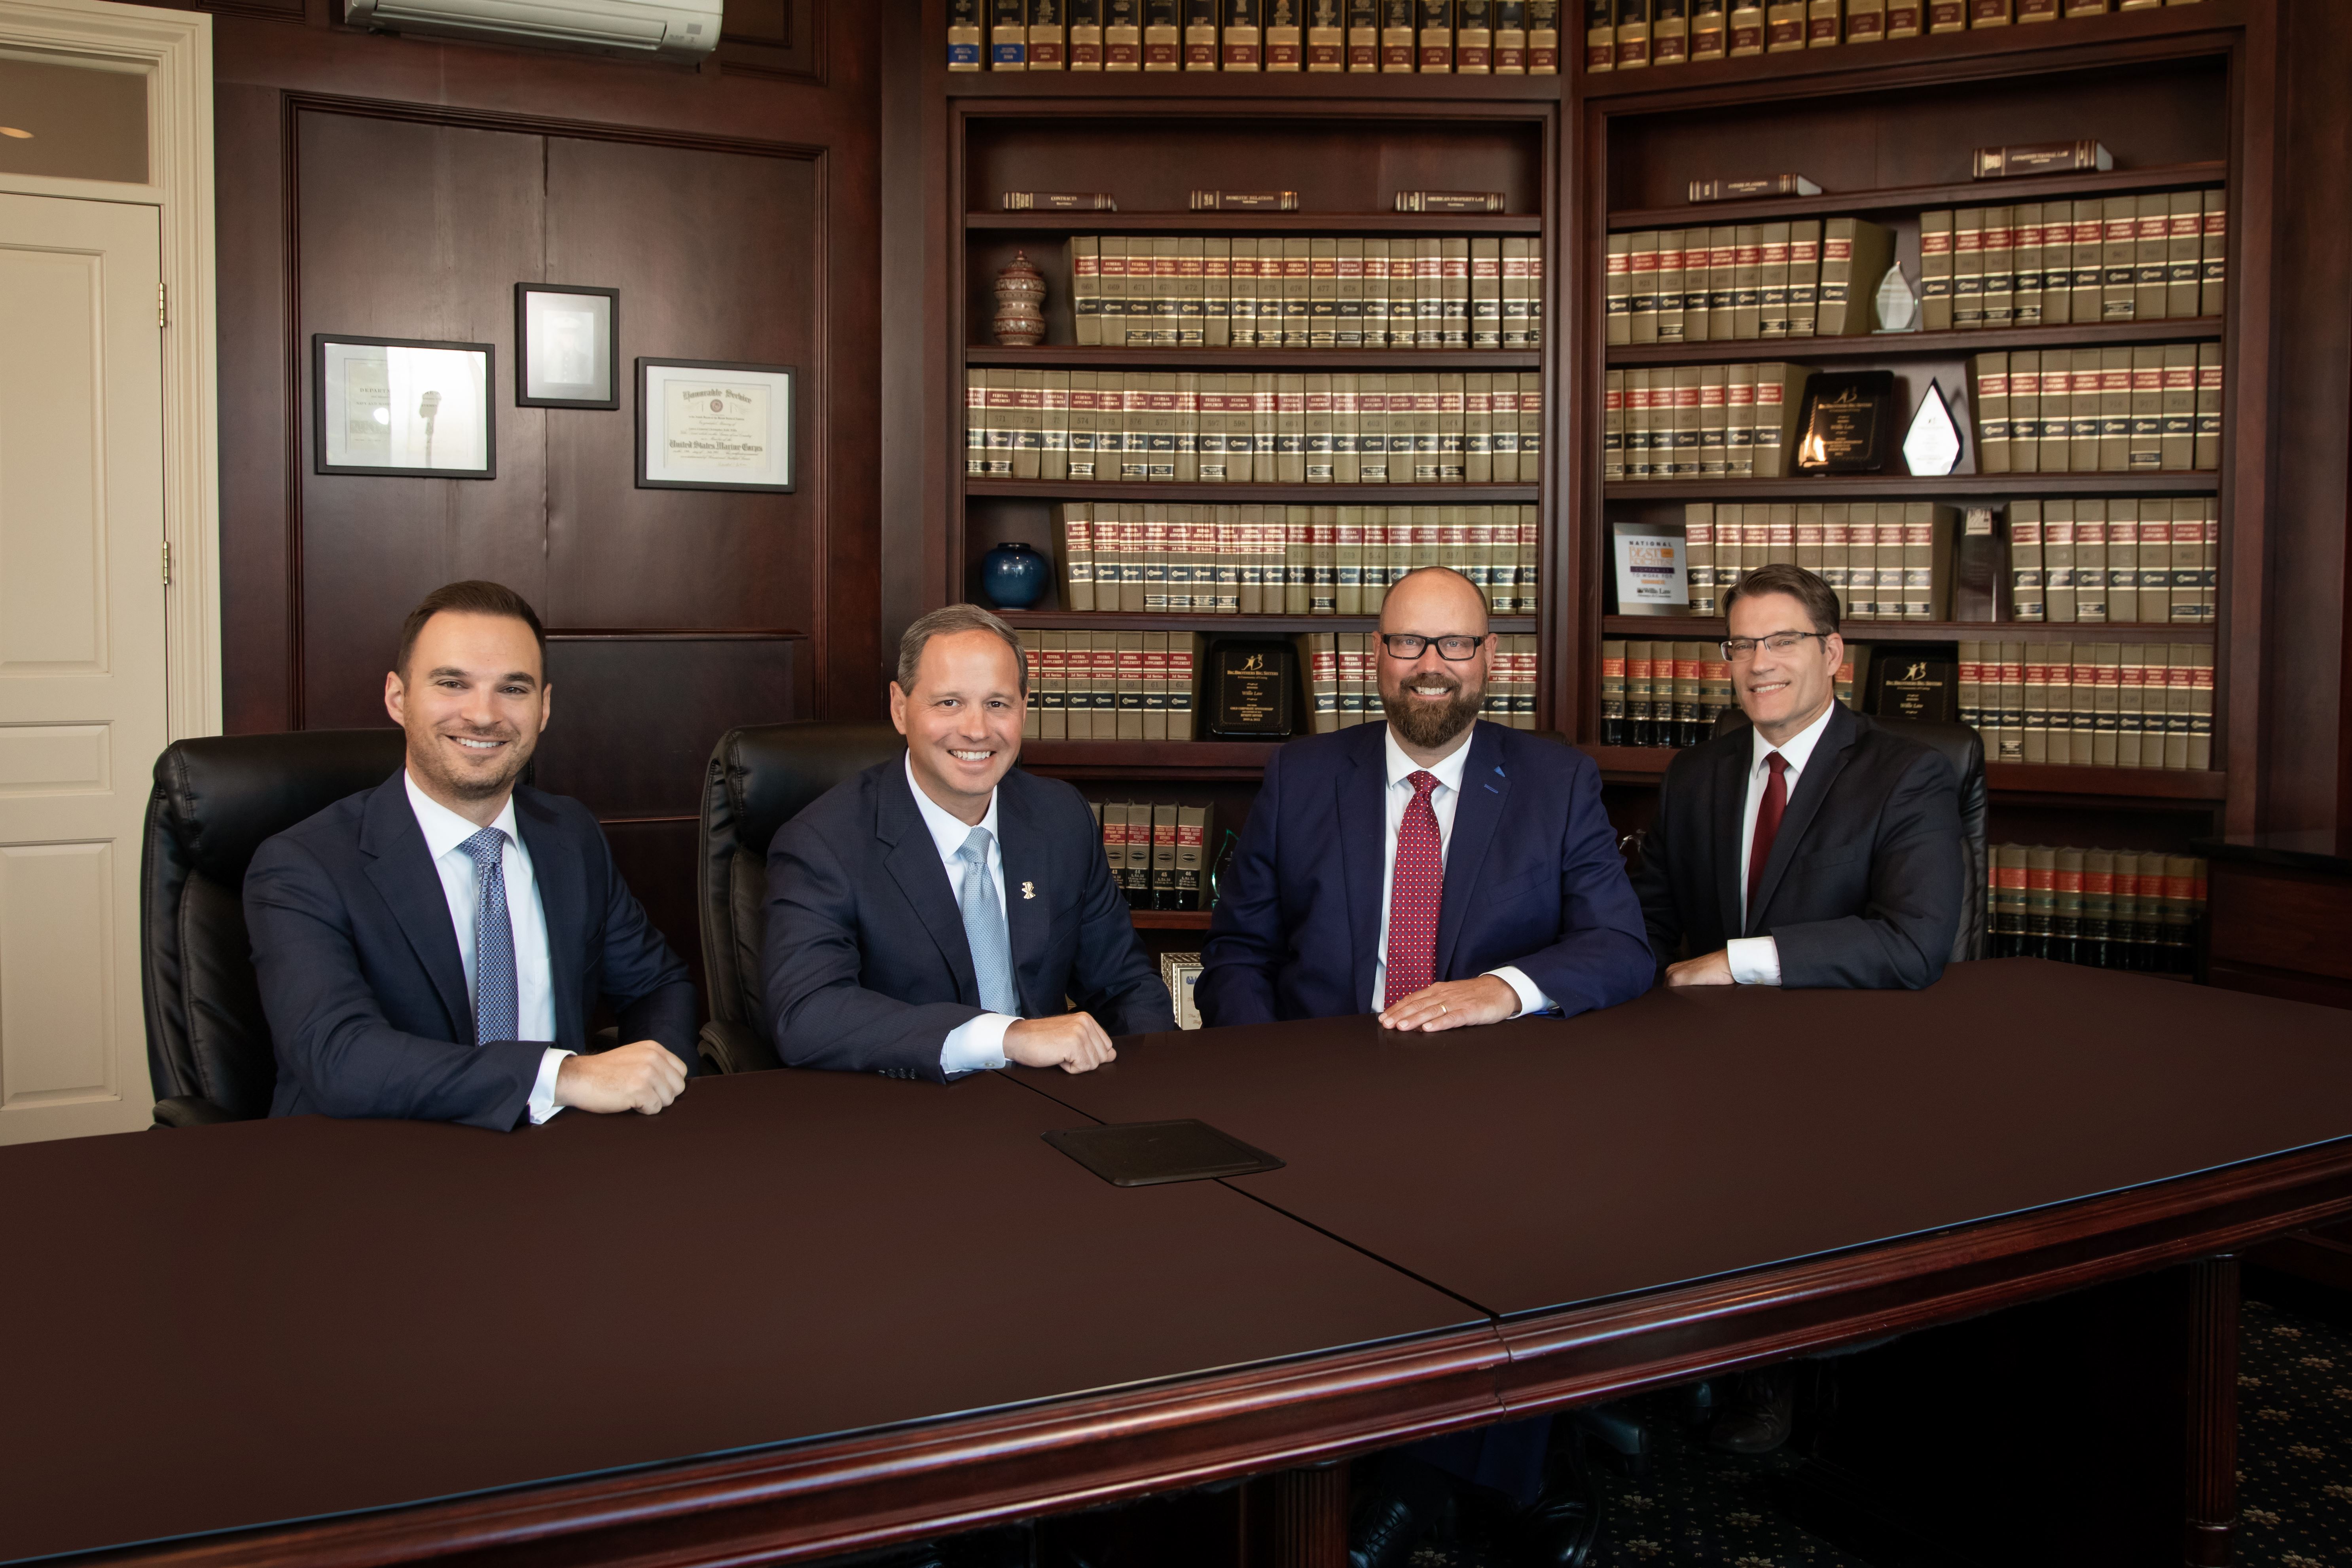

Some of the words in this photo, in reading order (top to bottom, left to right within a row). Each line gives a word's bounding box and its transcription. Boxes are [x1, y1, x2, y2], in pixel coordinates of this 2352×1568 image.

[683, 389, 722, 402] Honorable
[726, 389, 752, 404] Service
[669, 439, 692, 449] United
[693, 440, 715, 449] States
[716, 442, 741, 451] Marine
[742, 443, 763, 452] Corps
